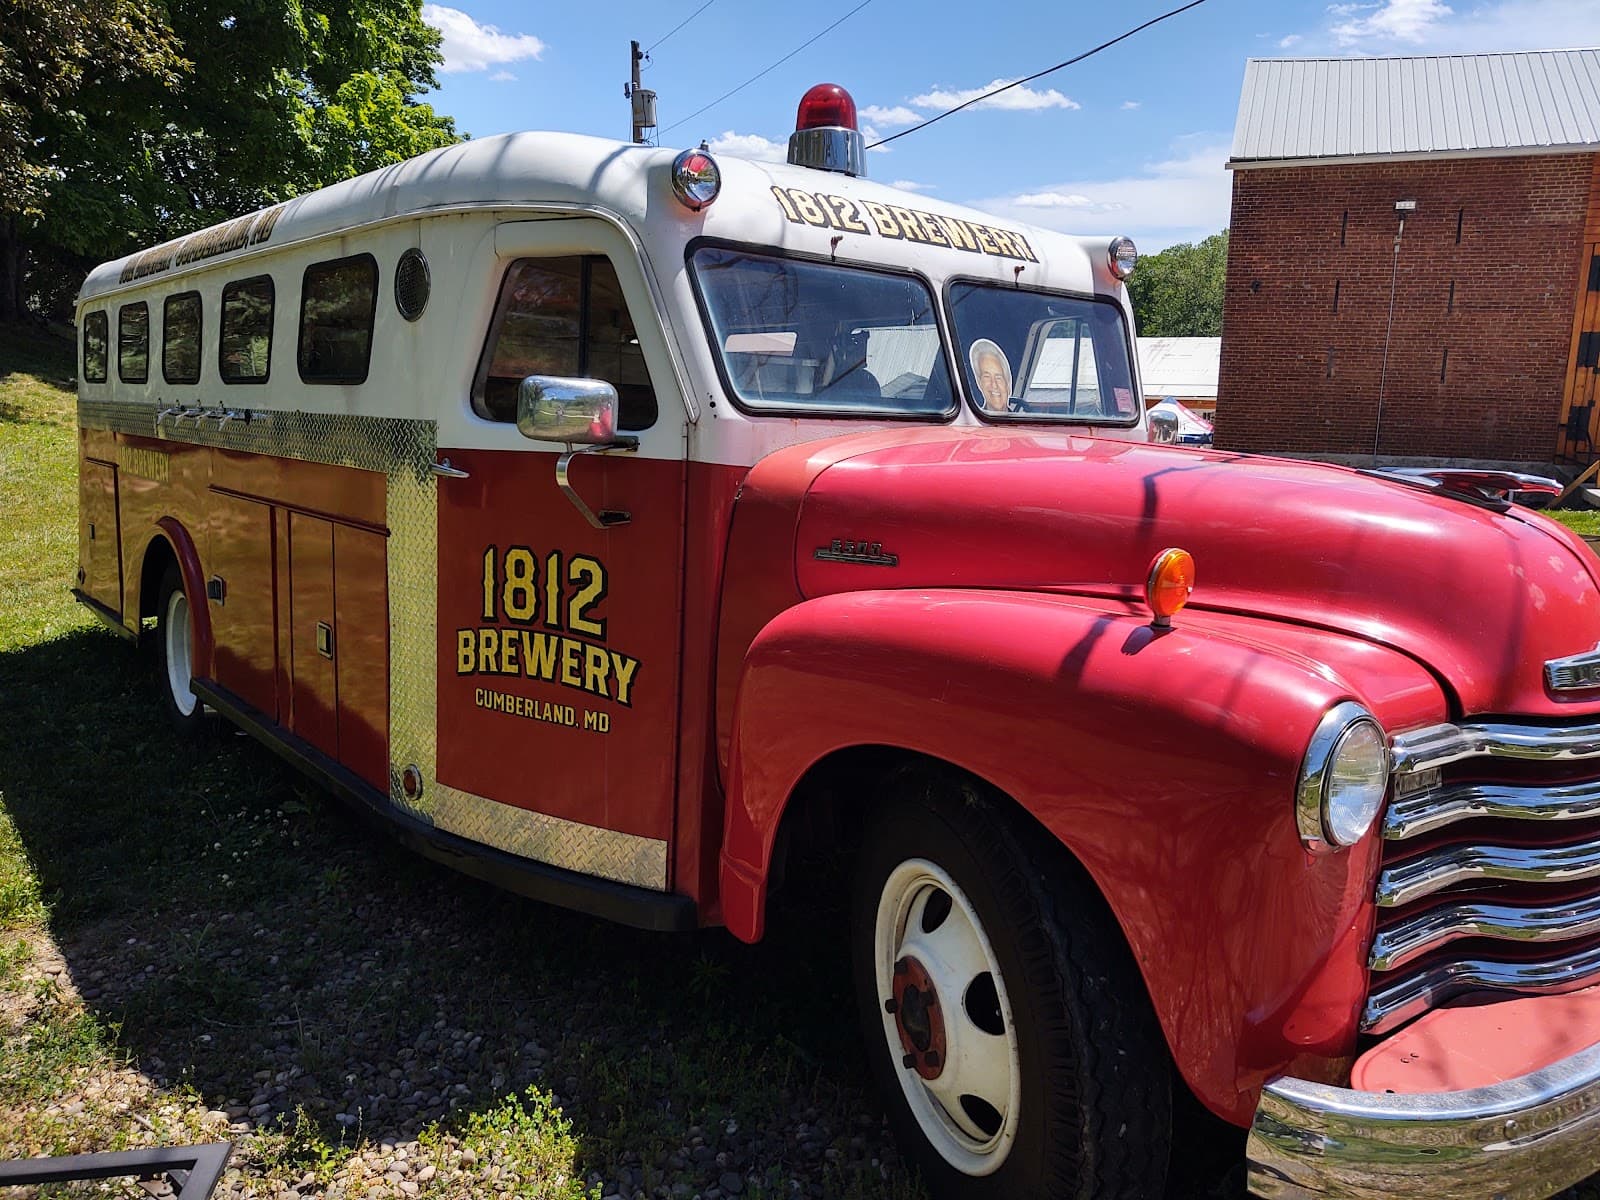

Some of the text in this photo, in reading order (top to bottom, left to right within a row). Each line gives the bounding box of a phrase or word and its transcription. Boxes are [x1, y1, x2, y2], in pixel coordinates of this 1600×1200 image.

[770, 185, 1040, 263] 1812 BREWERY
[481, 544, 608, 641] 1812
[456, 628, 641, 707] BREWERY
[584, 709, 610, 733] MD
